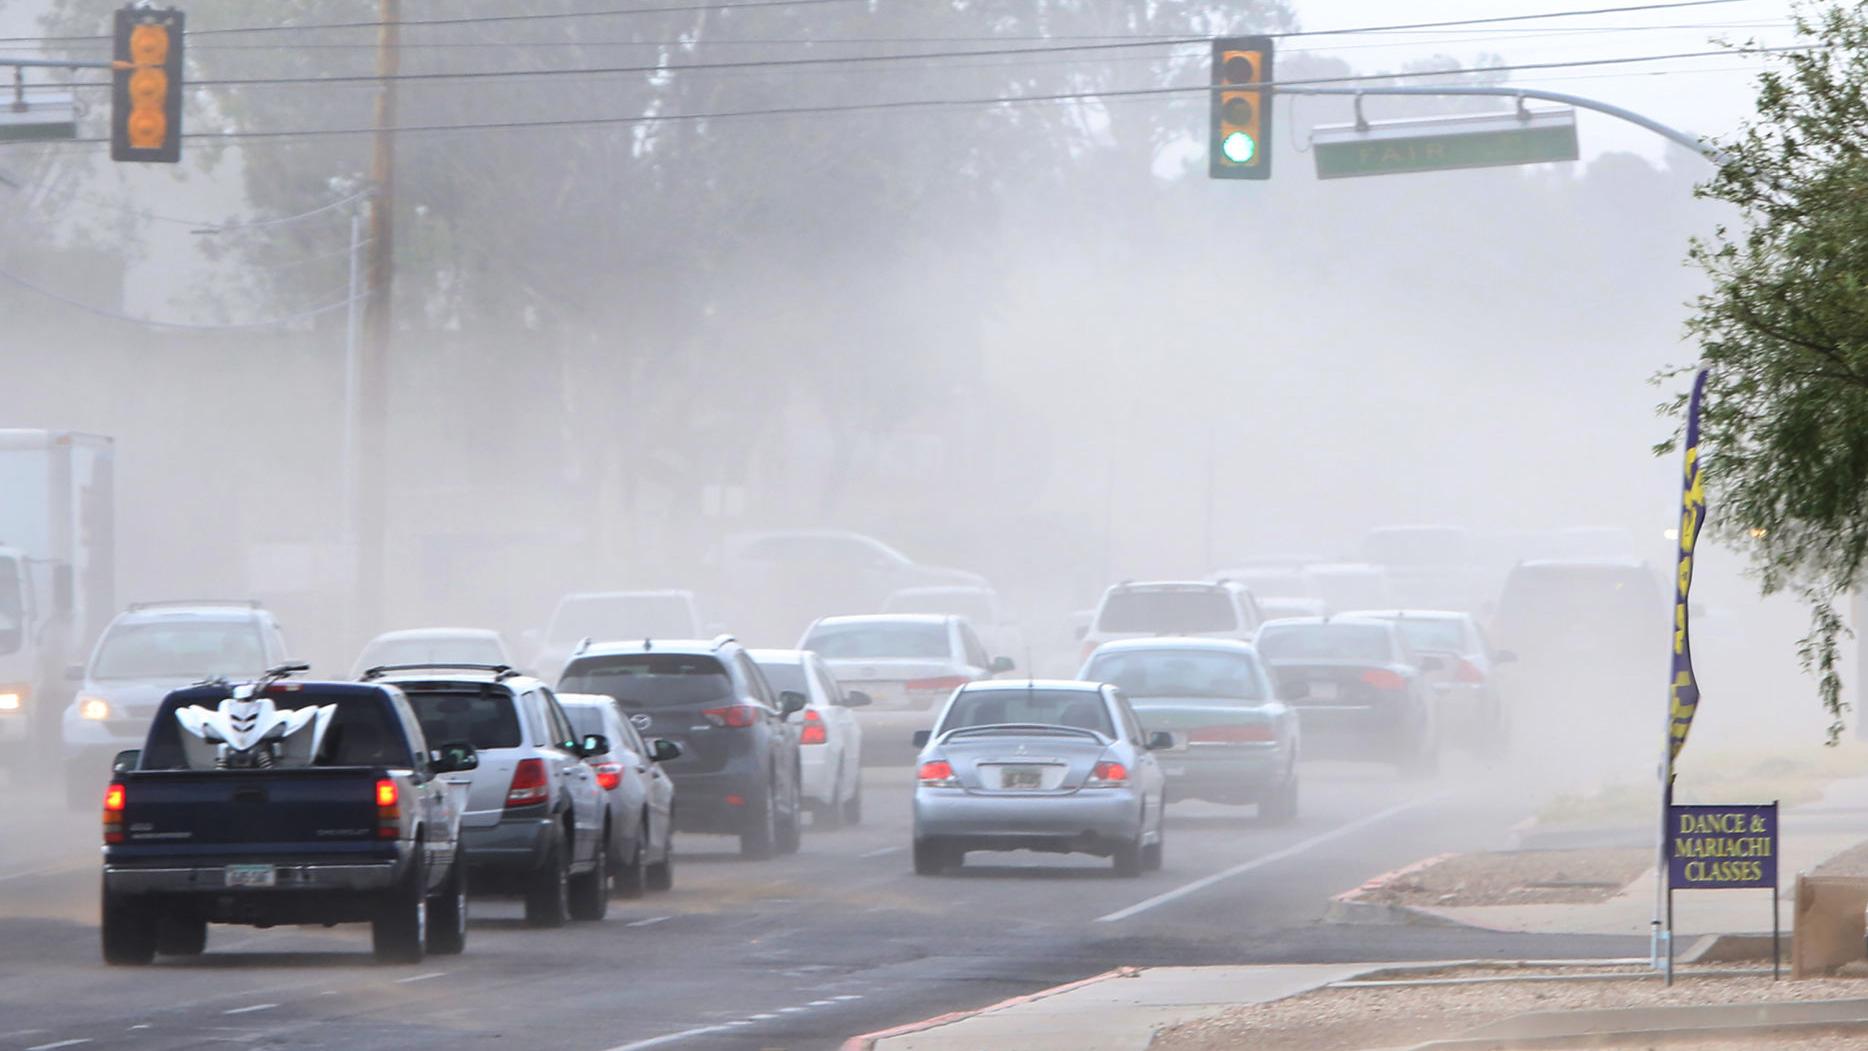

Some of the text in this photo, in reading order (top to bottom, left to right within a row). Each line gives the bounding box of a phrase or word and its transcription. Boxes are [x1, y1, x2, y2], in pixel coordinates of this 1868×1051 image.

[1680, 813, 1767, 833] DANCE &
[1674, 837, 1772, 857] MARIACHI
[1684, 860, 1762, 881] CLASSES
